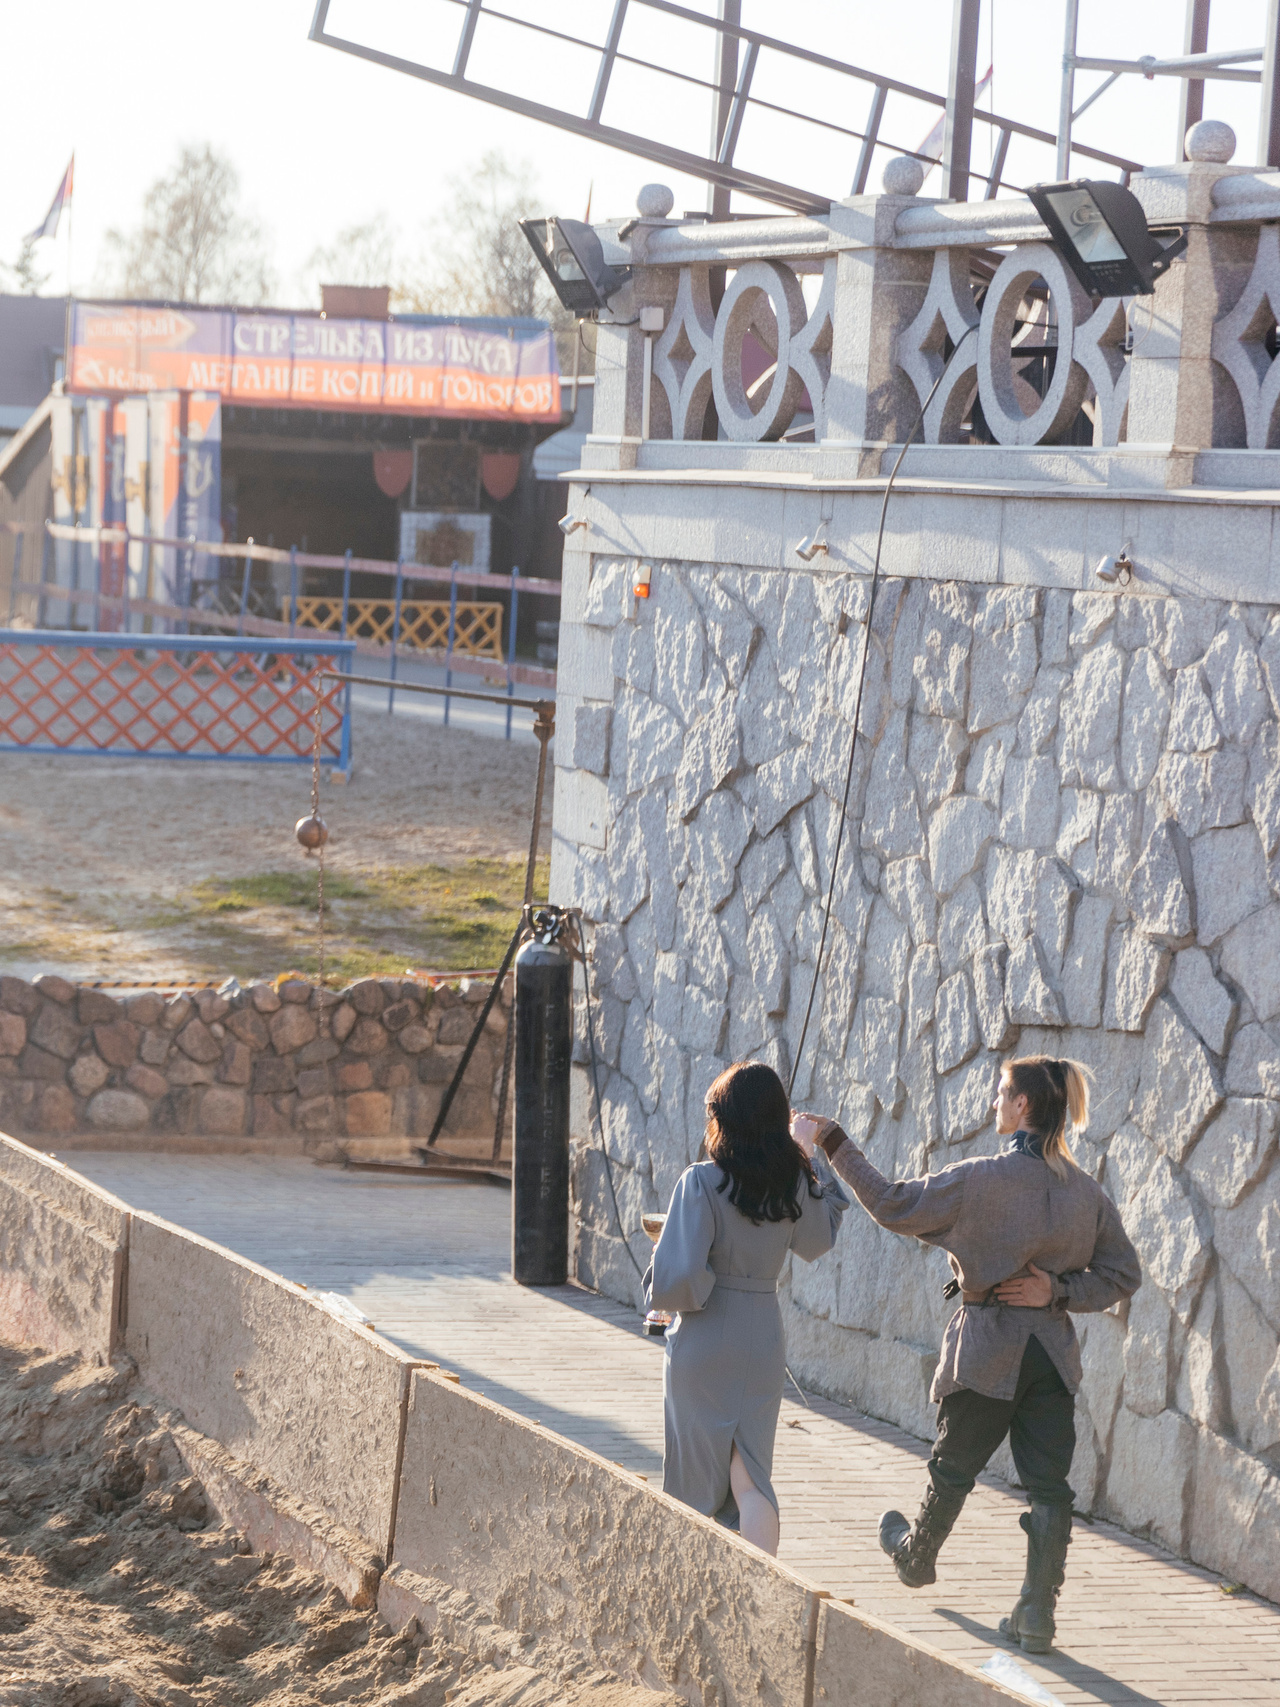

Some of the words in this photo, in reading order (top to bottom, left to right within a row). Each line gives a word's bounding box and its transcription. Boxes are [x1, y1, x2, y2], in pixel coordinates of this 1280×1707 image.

[234, 321, 385, 359] СТРЕЛЬБА
[394, 331, 434, 362] ИЗ
[438, 332, 516, 375] ЛУКА
[186, 360, 316, 394] МЕТАНИЕ
[321, 368, 414, 400] КОПИЙ
[438, 374, 554, 412] ТОПОРОВ
